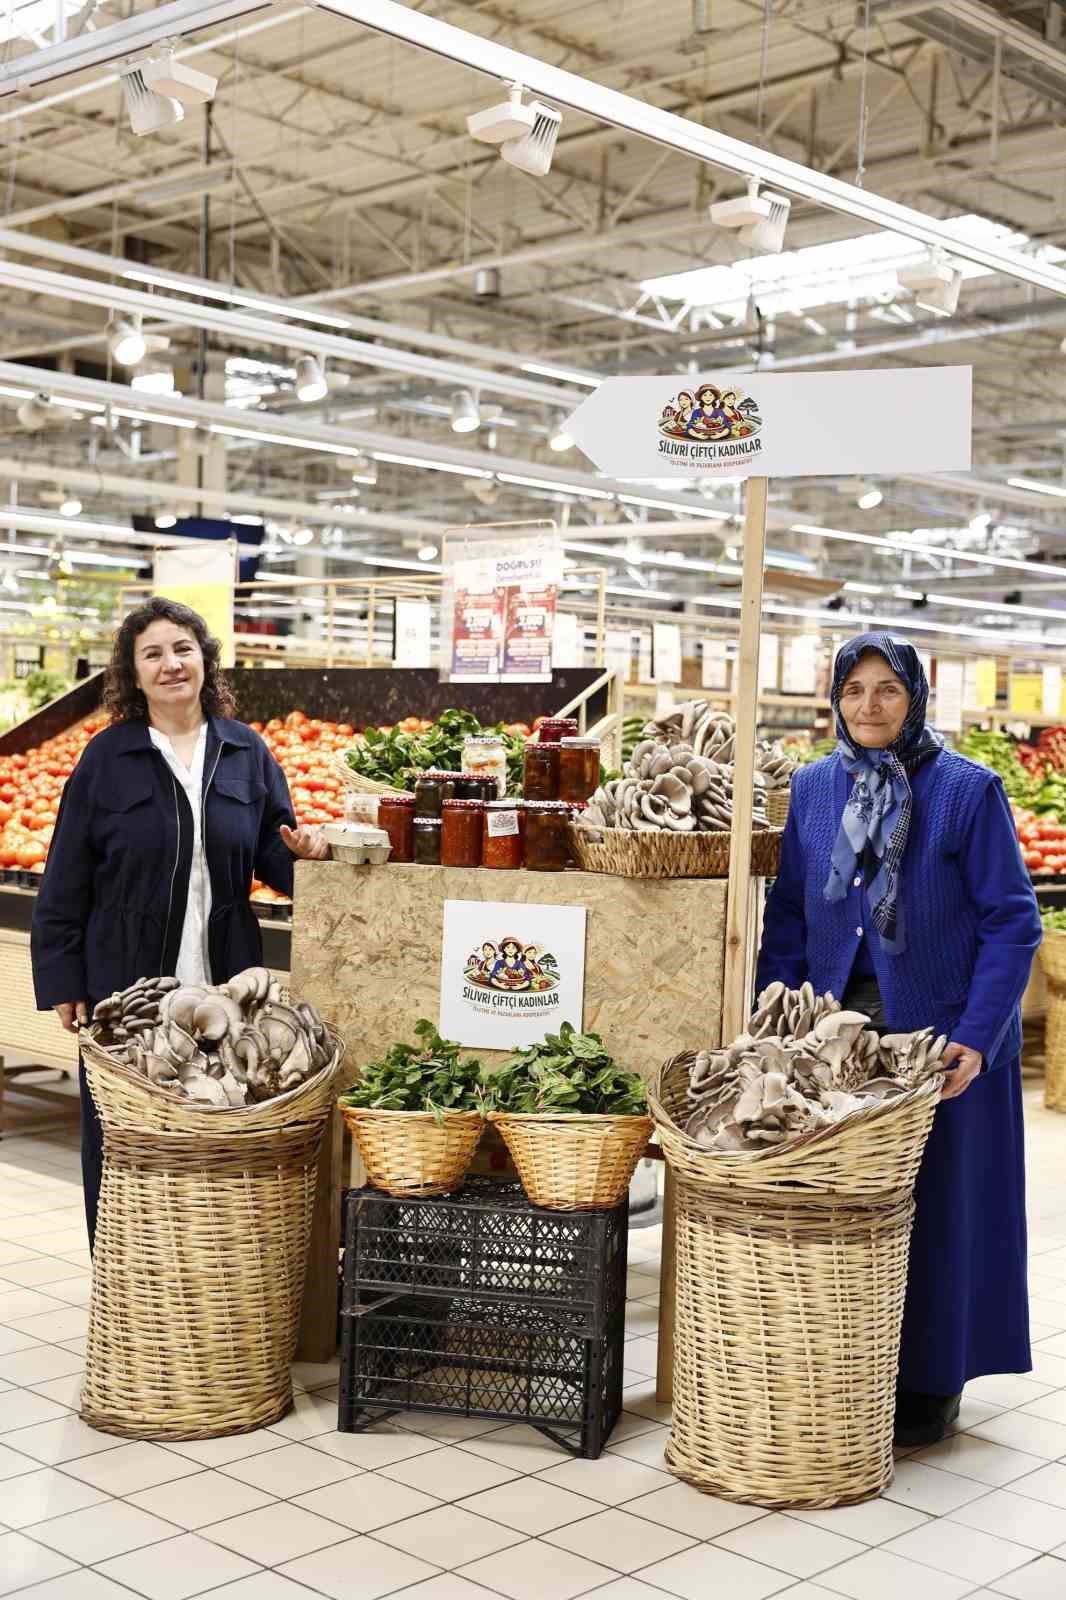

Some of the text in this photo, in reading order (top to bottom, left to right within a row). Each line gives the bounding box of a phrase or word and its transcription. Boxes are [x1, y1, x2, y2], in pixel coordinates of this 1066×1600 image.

[658, 438, 762, 460] SİLİVRİ ÇİFTÇİ KADINLAR
[462, 986, 560, 1009] SİLİVRİ ÇİFTÇİ KADINLAR
